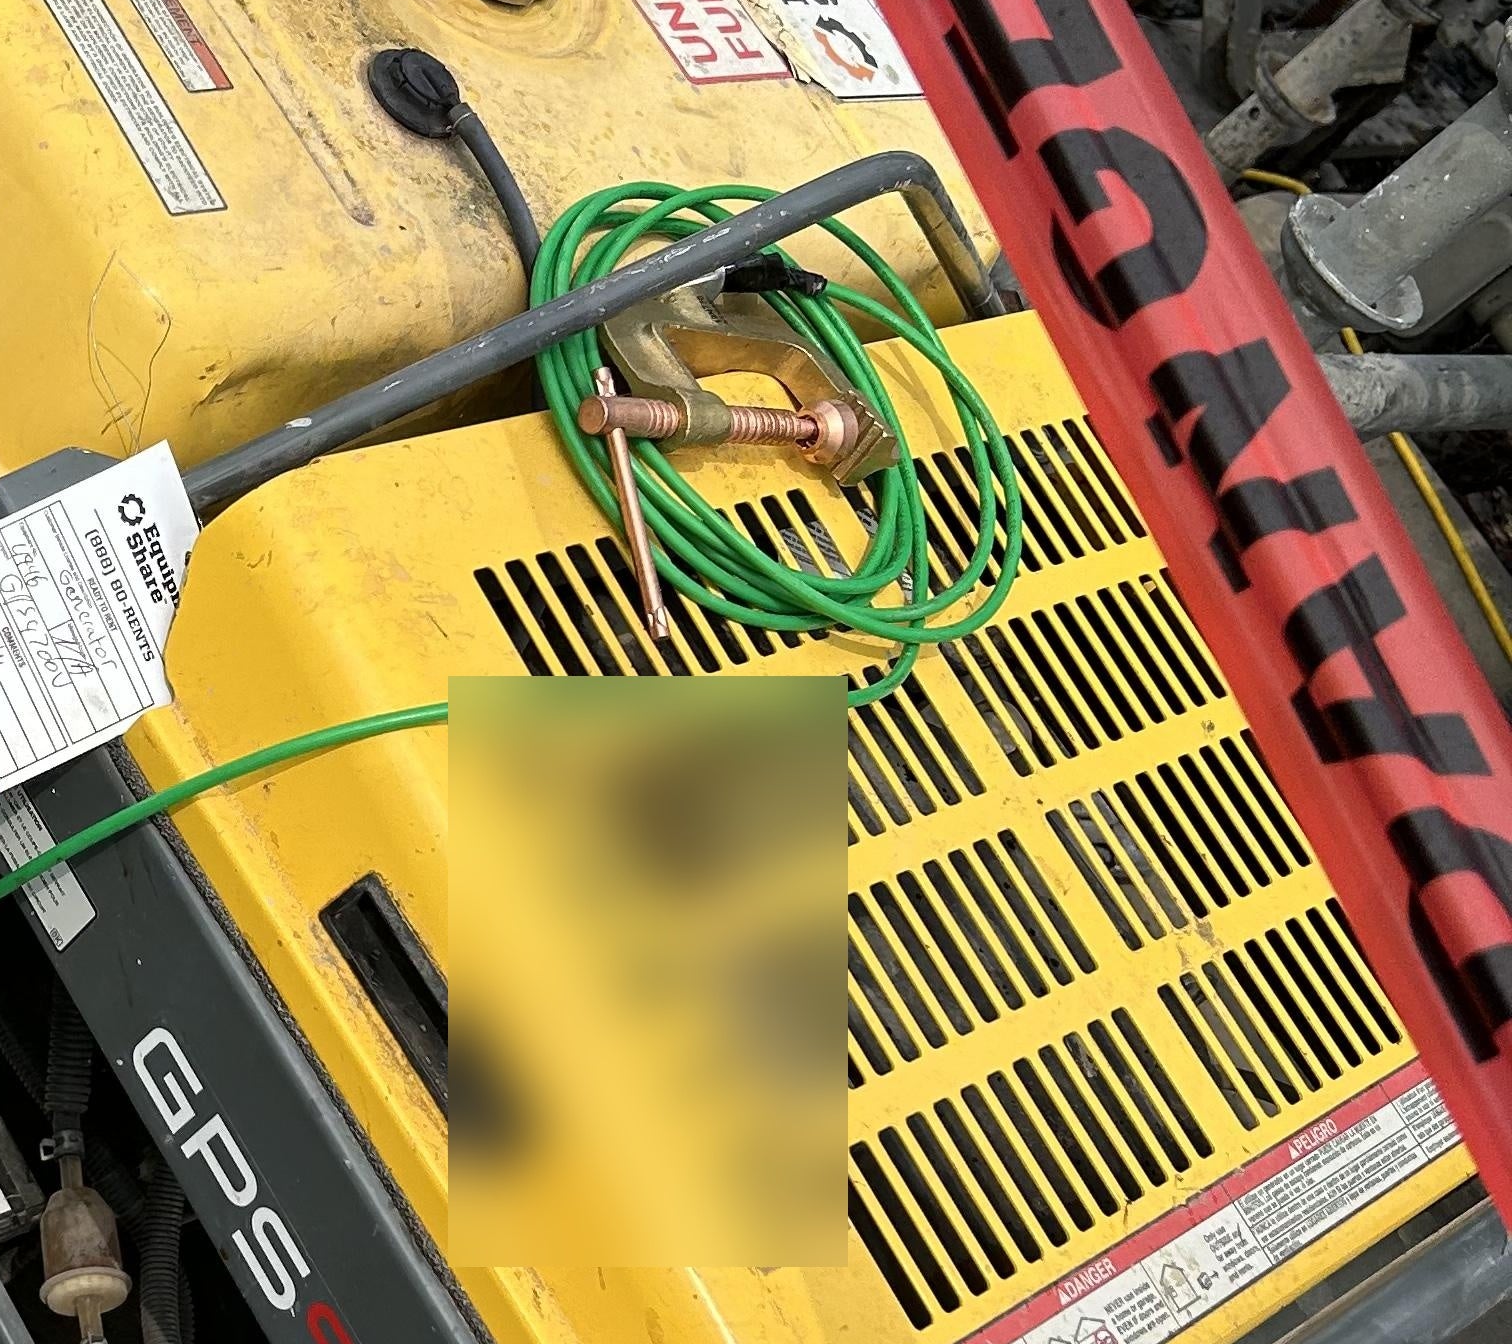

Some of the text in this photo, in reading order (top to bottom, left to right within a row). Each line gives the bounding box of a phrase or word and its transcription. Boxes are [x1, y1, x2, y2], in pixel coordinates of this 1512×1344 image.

[137, 522, 192, 610] Equip
[83, 527, 157, 663] (888) 80-RENTS
[85, 577, 117, 633] READY TO RENT
[0, 625, 26, 668] COMMENTS
[1292, 1117, 1339, 1154] PELIGRO
[1061, 1255, 1118, 1299] DANGER
[1102, 1296, 1125, 1314] NEVER
